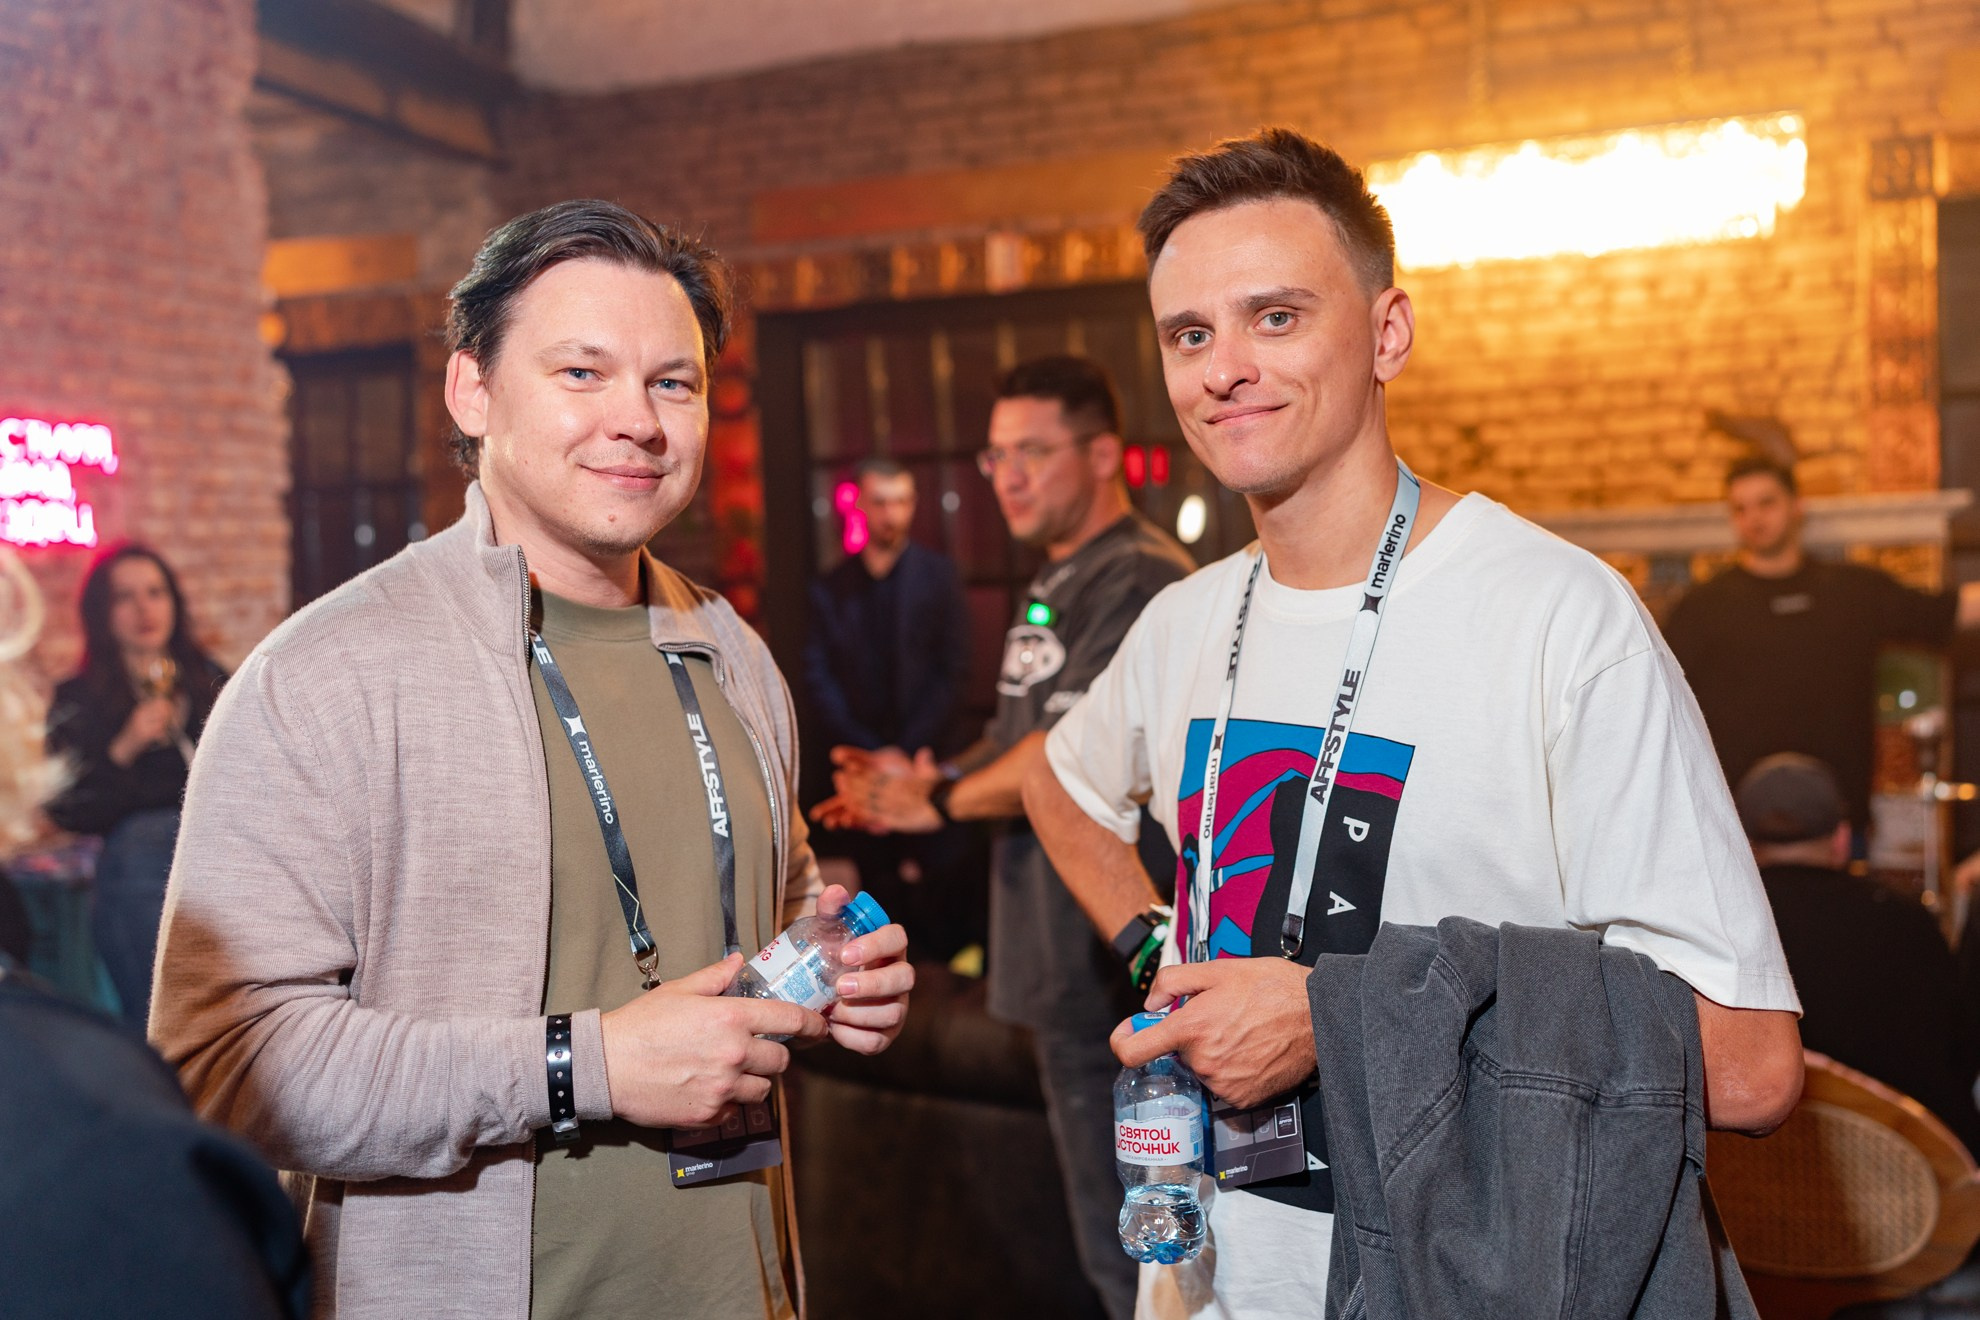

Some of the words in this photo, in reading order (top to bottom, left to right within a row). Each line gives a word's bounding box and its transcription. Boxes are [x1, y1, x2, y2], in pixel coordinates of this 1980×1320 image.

[1371, 513, 1406, 589] marlerino
[687, 713, 729, 837] AFFSTYLE
[1310, 669, 1361, 805] AFFSTYLE
[579, 740, 614, 824] marlerino
[1203, 758, 1218, 839] marlerino
[685, 1162, 713, 1172] marlerino
[1120, 1125, 1170, 1140] СВЯТОЙ
